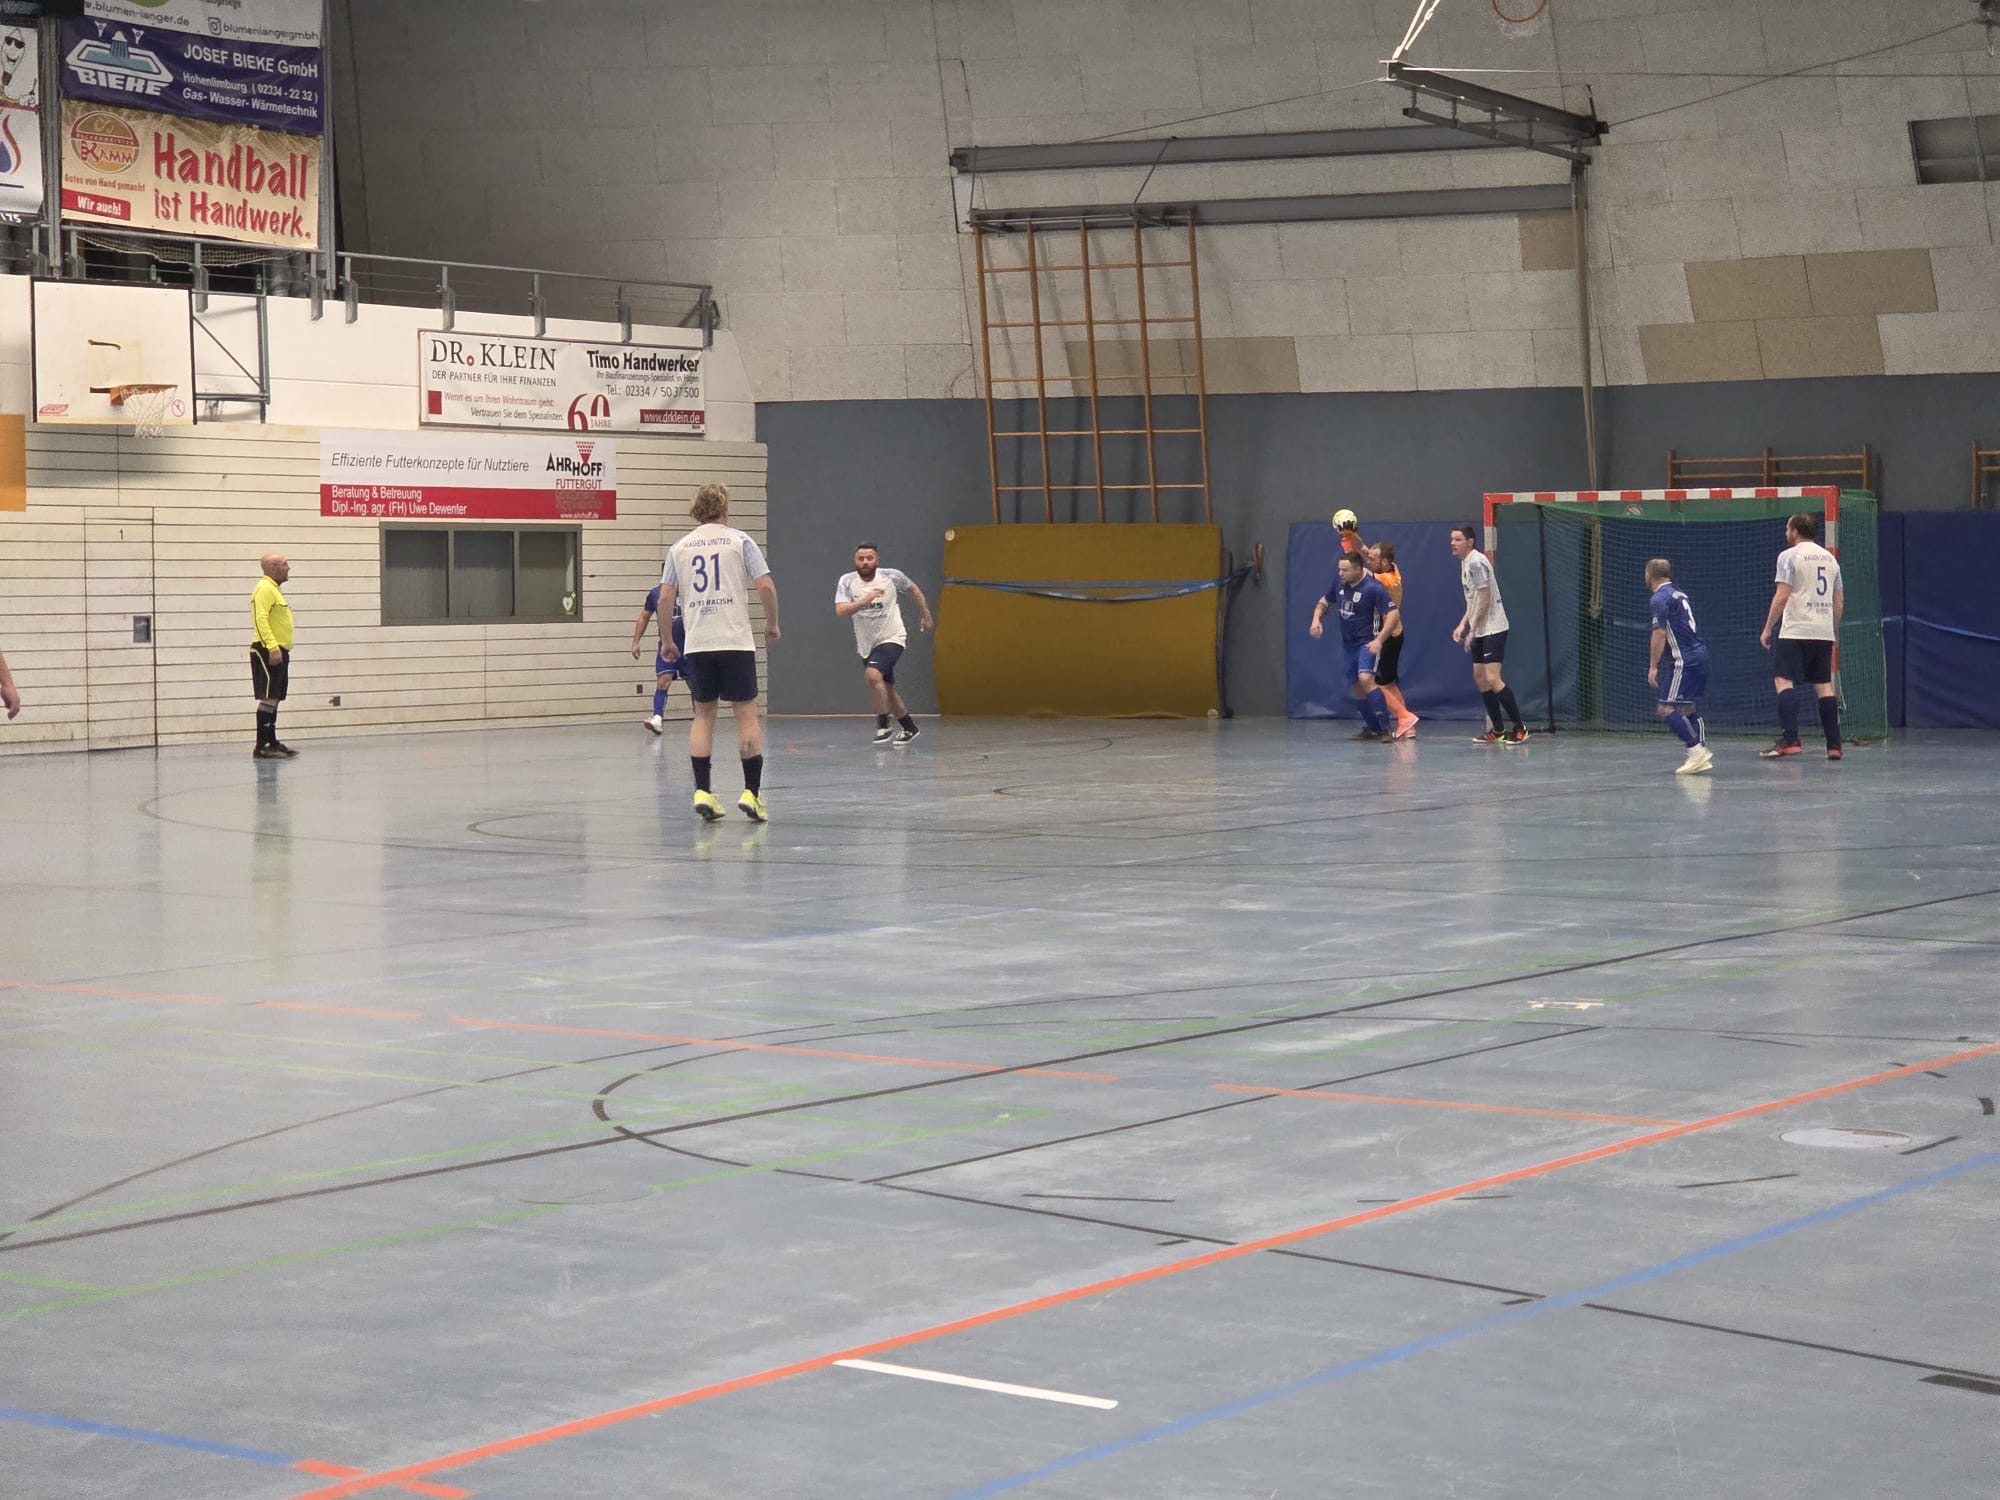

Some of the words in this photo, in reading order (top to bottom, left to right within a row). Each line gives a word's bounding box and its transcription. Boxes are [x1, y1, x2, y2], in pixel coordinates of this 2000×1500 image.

[184, 44, 229, 64] JOSEF
[233, 52, 275, 72] BIEKE
[278, 60, 318, 78] GmbH
[68, 65, 170, 95] BIEKE
[182, 72, 248, 93] Hohenlimburg
[257, 83, 282, 96] 02334
[289, 88, 300, 99] 22
[302, 91, 313, 101] 32
[183, 87, 207, 100] Gas-
[209, 91, 249, 107] Wasser-
[251, 97, 318, 118] Wärmetechnik
[80, 140, 133, 164] KAMM
[154, 131, 308, 201] Handball
[98, 177, 117, 189] Hand
[77, 195, 95, 211] Wir
[96, 201, 122, 216] auch!
[154, 188, 182, 222] ist
[190, 190, 311, 239] Handwerk.
[586, 350, 620, 369] Timo
[623, 352, 700, 372] Handwerker
[432, 370, 447, 380] DER
[449, 371, 482, 383] PARTNER
[484, 372, 498, 383] FÜR
[500, 375, 517, 385] IHRE
[519, 376, 556, 387] FINANZEN
[444, 391, 464, 401] Wenn
[465, 394, 473, 402] es
[625, 385, 651, 397] 02334
[660, 386, 673, 397] 50
[673, 387, 682, 397] 37
[684, 387, 700, 398] 500
[470, 406, 501, 418] Vertrauen
[503, 408, 512, 418] Sie
[513, 409, 527, 419] dem
[590, 418, 613, 428] JAHRE
[643, 411, 701, 424] www.drklein.de
[331, 452, 382, 468] Effiziente
[385, 454, 465, 472] Futterkonzepte
[467, 457, 482, 470] für
[484, 457, 530, 472] Nutztiere
[546, 451, 602, 477] AHRHOFF
[332, 485, 370, 501] Beratung
[371, 486, 378, 498] &
[380, 487, 422, 502] Betreuung
[556, 478, 602, 489] FUTTERGUT
[332, 500, 369, 516] Dipl.-Ing.
[371, 504, 387, 516] agr.
[388, 502, 407, 517] (FH)
[409, 502, 427, 515] Uwe
[429, 503, 467, 515] Dewenter
[692, 552, 720, 593] 31
[1816, 566, 1827, 596] 5
